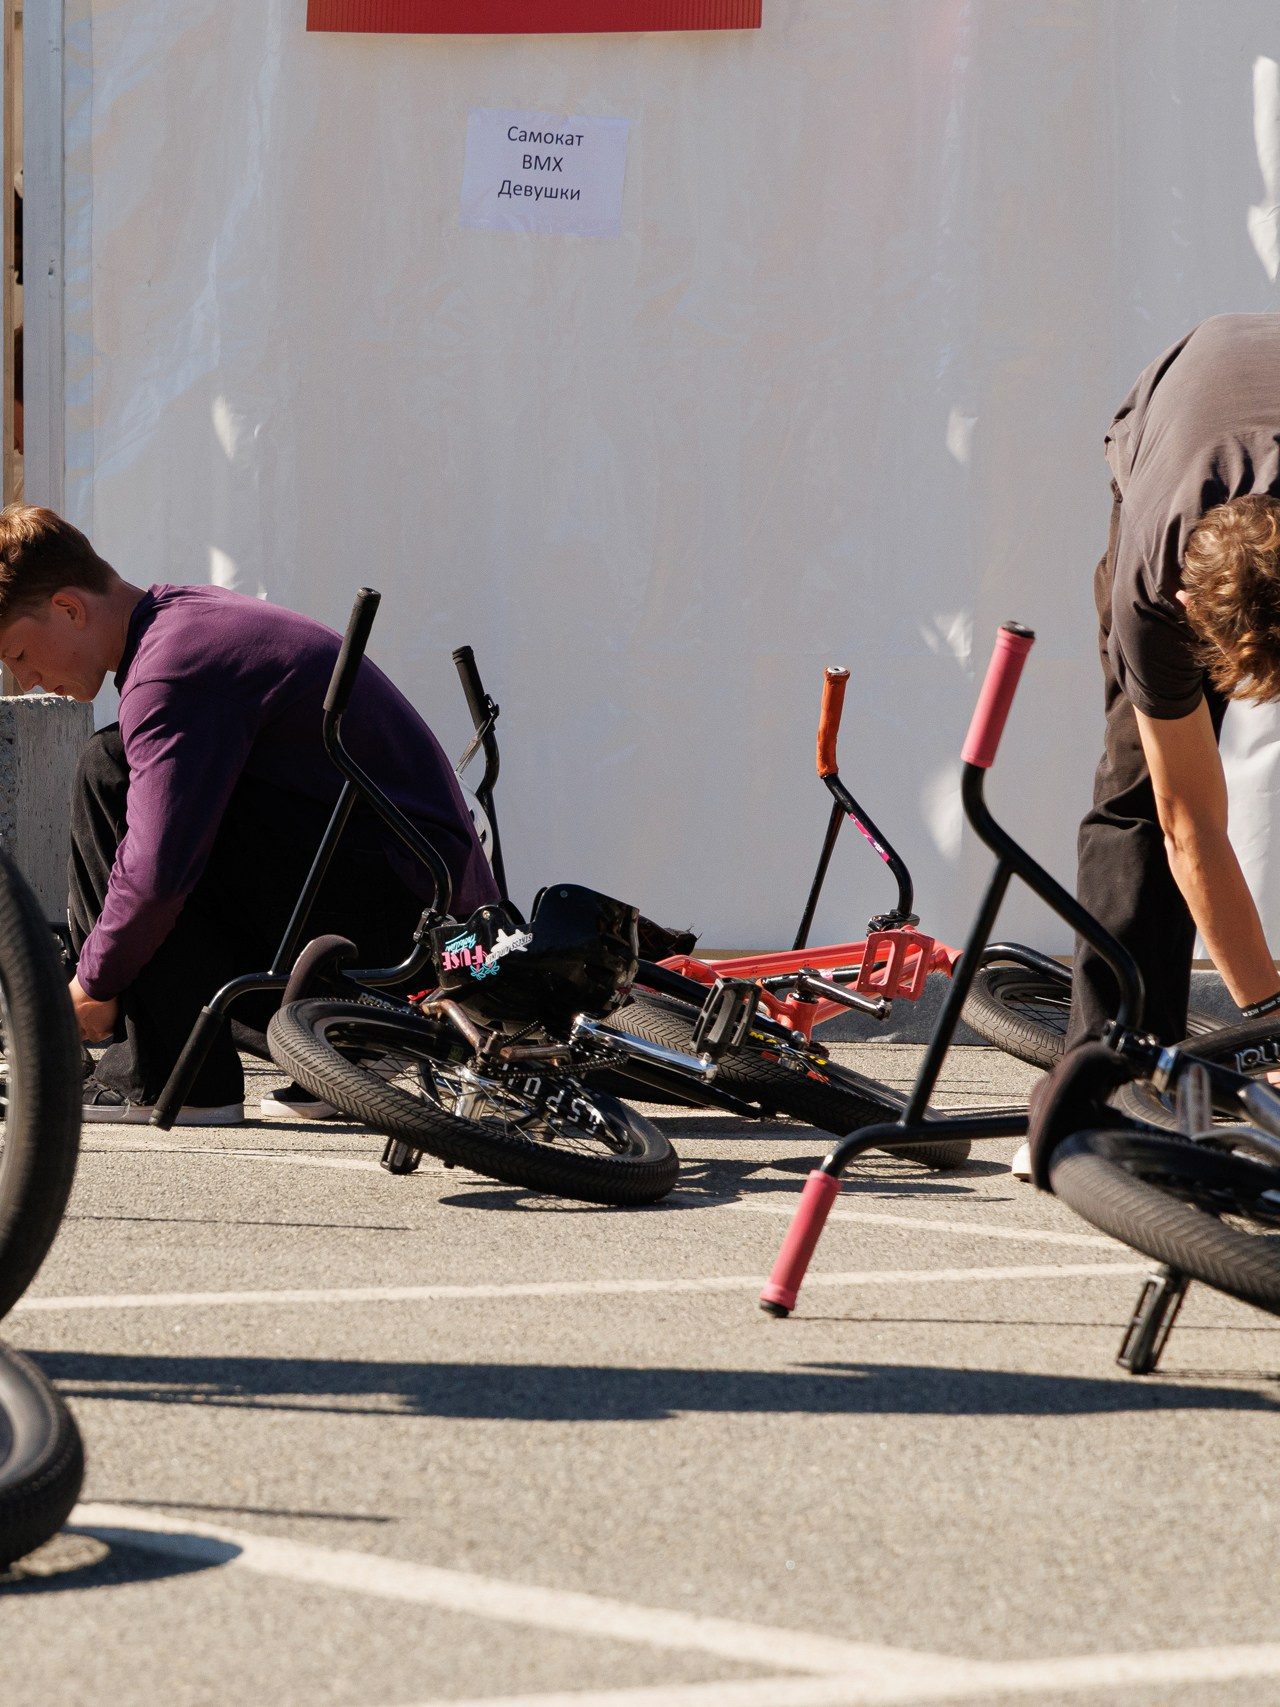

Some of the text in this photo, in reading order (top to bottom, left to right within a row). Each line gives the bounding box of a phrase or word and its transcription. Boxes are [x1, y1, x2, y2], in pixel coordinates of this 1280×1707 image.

[507, 126, 584, 146] Самокат
[497, 180, 581, 201] Девушки
[441, 944, 484, 971] FUSE
